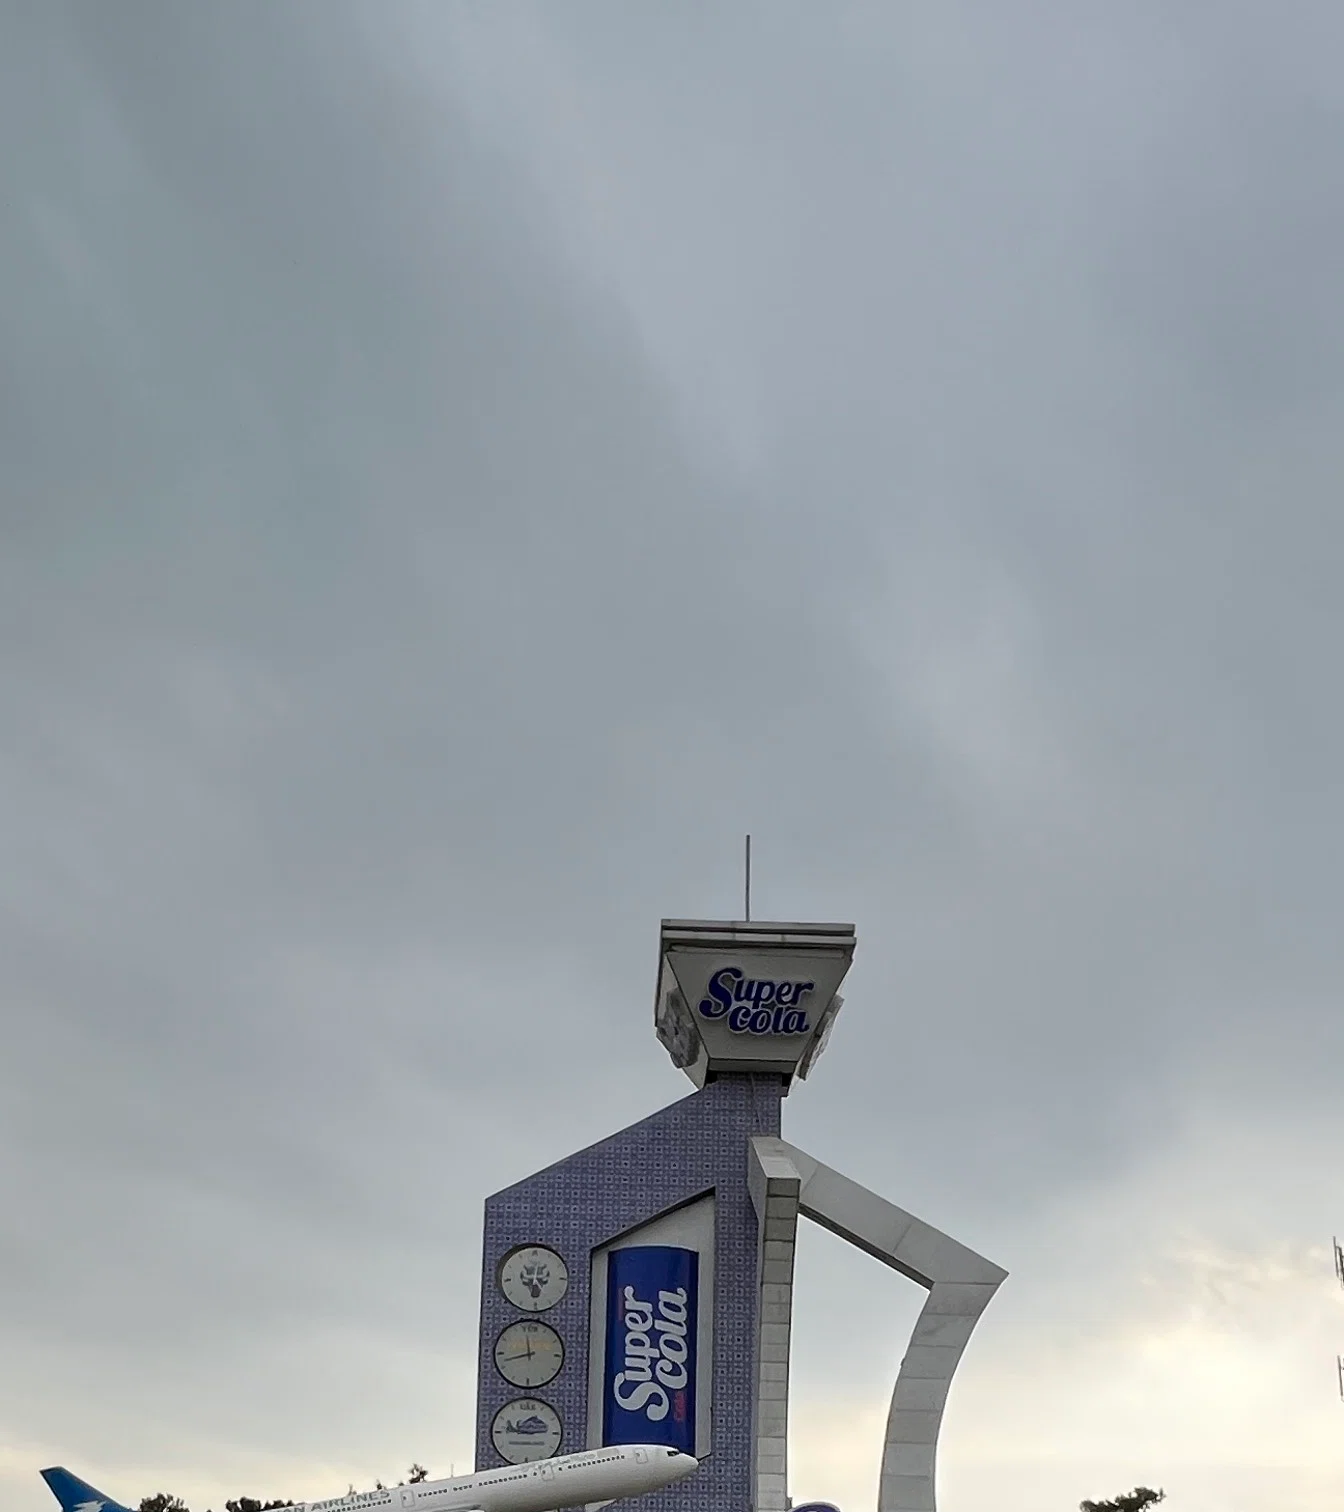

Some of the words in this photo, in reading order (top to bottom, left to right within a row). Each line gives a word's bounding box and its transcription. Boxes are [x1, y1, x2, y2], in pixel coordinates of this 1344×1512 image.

[698, 967, 814, 1018] Super
[728, 1005, 810, 1034] cola
[613, 1285, 670, 1422] Super
[655, 1287, 689, 1390] cola
[310, 1489, 391, 1511] AIRLINES
